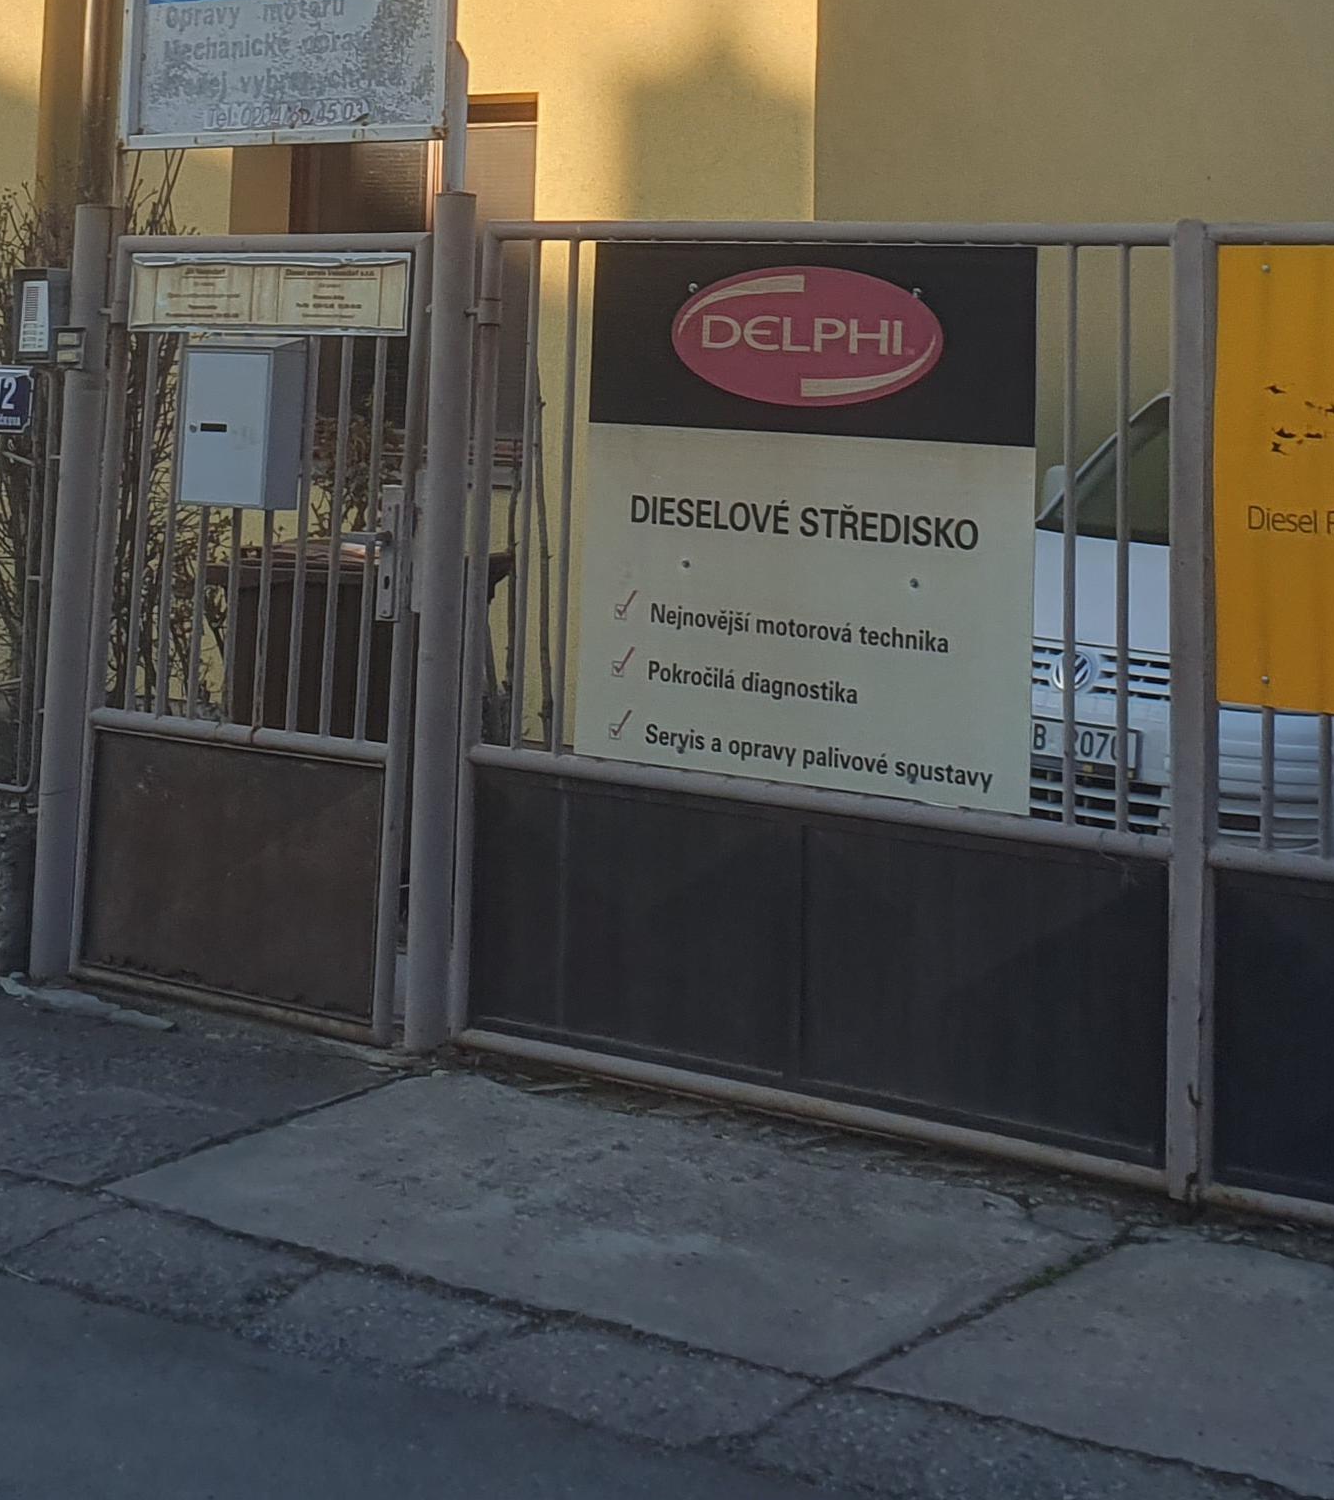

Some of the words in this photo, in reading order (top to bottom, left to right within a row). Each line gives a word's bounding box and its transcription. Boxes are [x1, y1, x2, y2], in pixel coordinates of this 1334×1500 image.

[166, 4, 241, 32] Opravy
[701, 314, 903, 355] DELPHI
[630, 494, 789, 535] DIESELOVÉ
[799, 503, 980, 551] STŘEDISKO
[1247, 504, 1318, 534] Diesel
[650, 602, 750, 637] Nejnovější
[756, 617, 853, 644] motorová
[859, 626, 949, 653] technika
[647, 660, 735, 690] Pokročilá
[741, 671, 858, 705] diagnostika
[644, 723, 705, 751] Servis
[710, 736, 722, 753] a
[728, 738, 797, 769] opravy
[802, 747, 889, 775] palivové
[895, 762, 994, 793] soustavy
